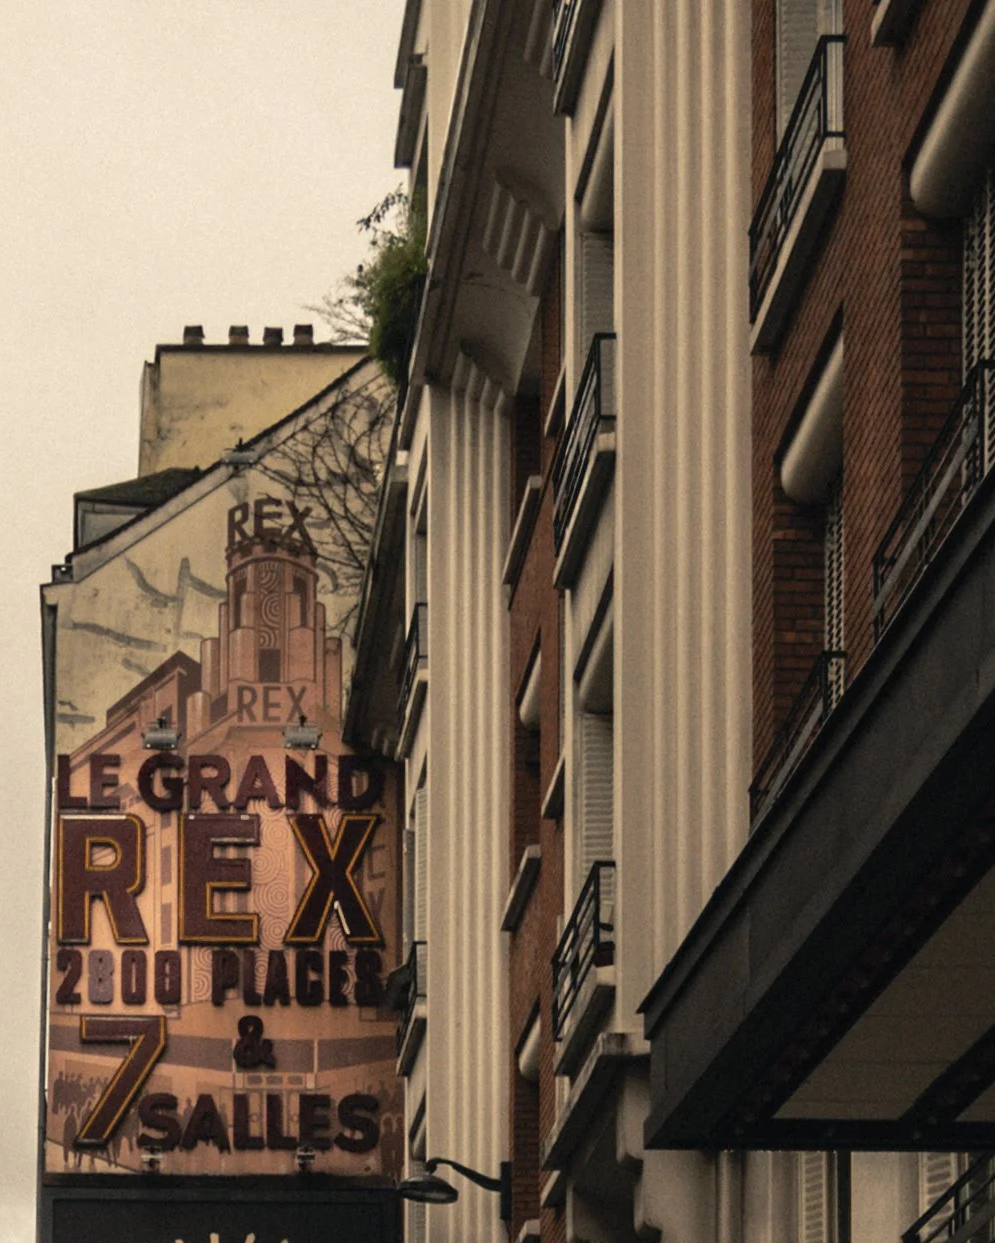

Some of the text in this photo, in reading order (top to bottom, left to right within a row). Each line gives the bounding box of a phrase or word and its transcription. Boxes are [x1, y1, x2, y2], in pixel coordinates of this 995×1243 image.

[228, 498, 313, 547] REX
[236, 685, 307, 725] REX
[57, 752, 384, 812] LE GRAND
[57, 813, 383, 945] REX
[56, 949, 384, 1006] 2800 PLACES
[233, 1015, 276, 1068] &
[74, 1014, 380, 1154] 7 SALLES
